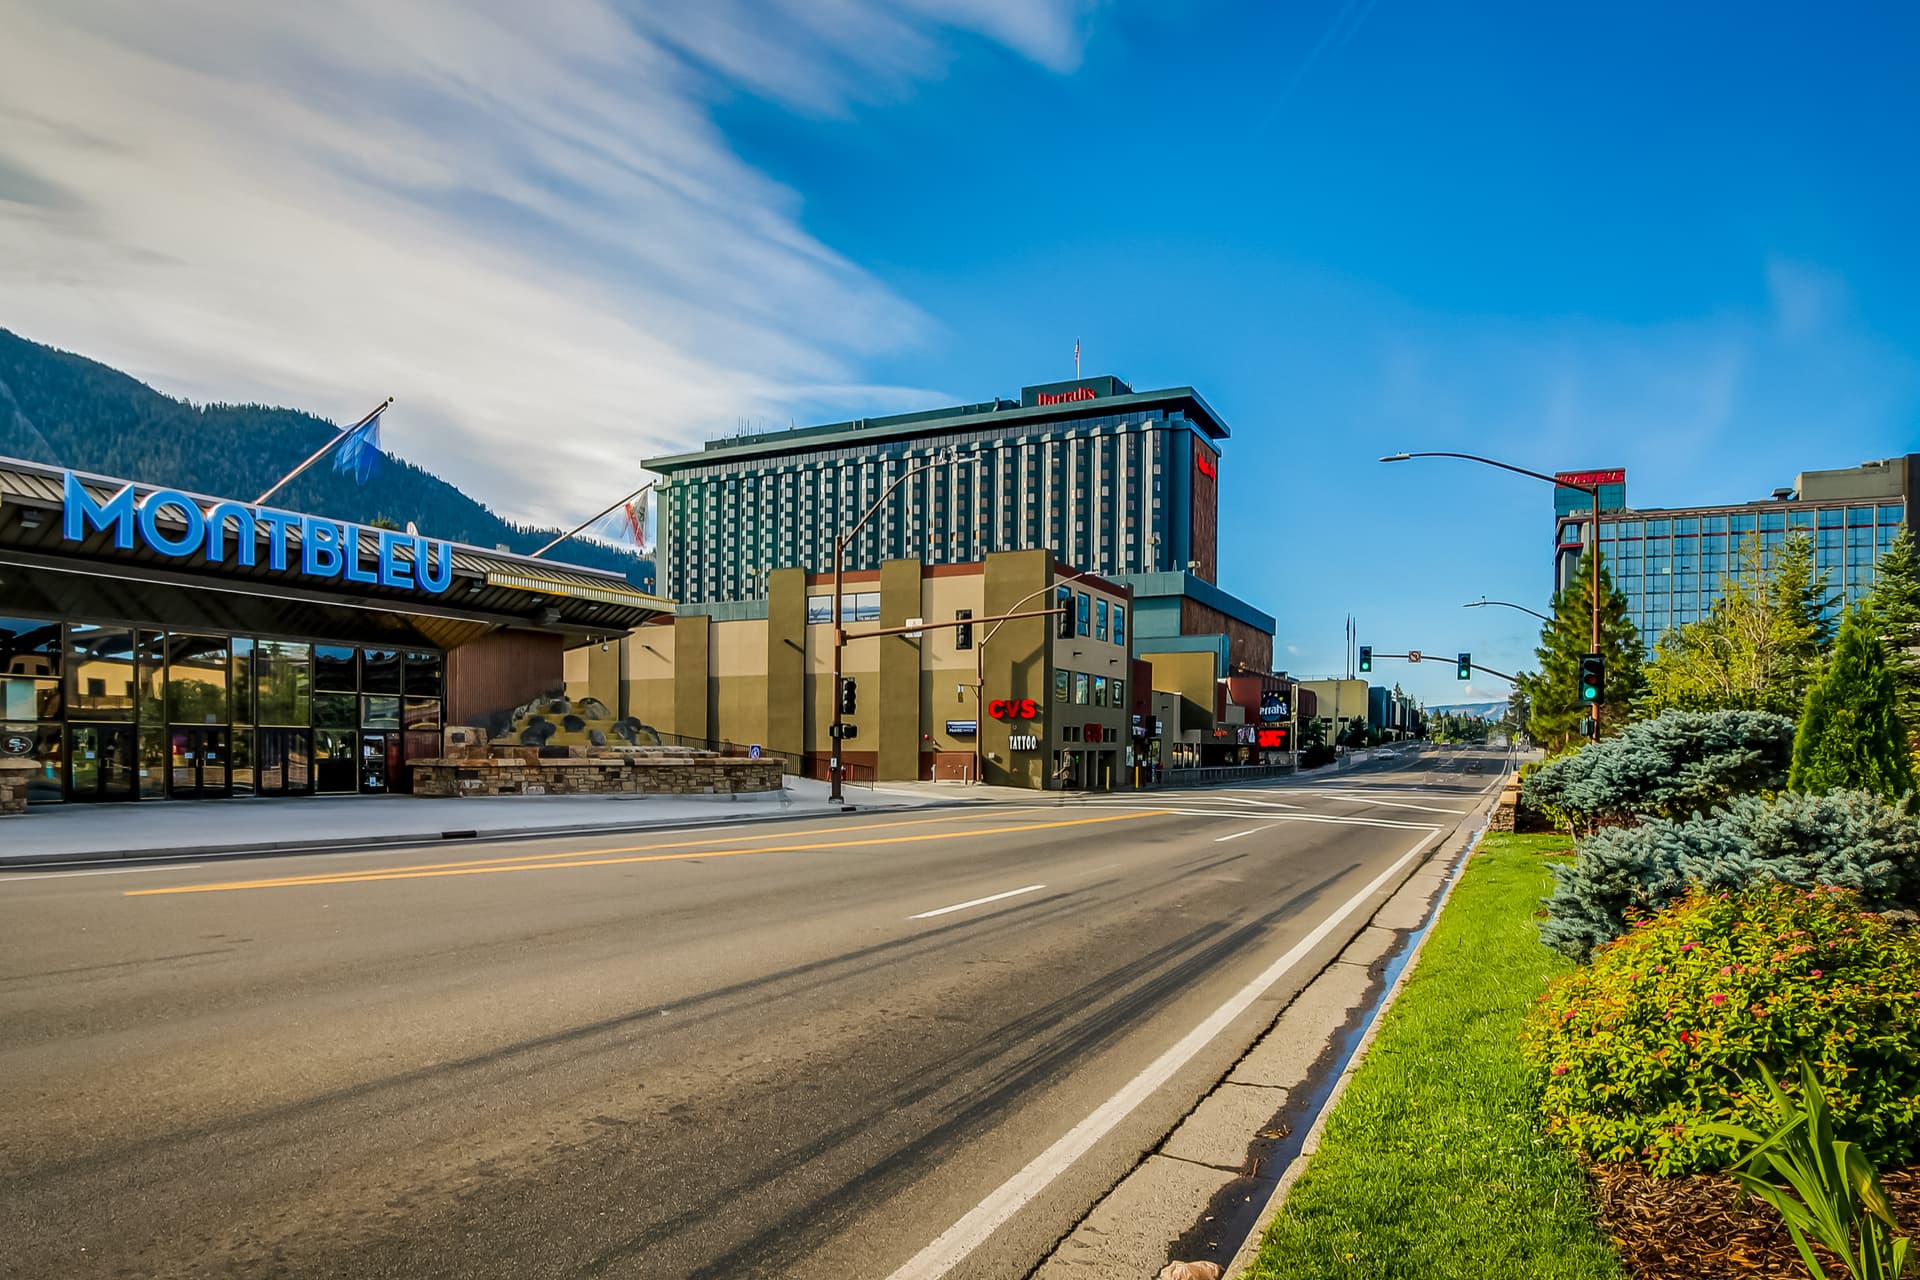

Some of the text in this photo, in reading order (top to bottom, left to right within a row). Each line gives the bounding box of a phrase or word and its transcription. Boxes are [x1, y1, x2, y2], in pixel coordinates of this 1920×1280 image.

[63, 470, 453, 594] MONTBLEU
[988, 698, 1037, 719] CVS
[1008, 735, 1037, 750] TATTOO
